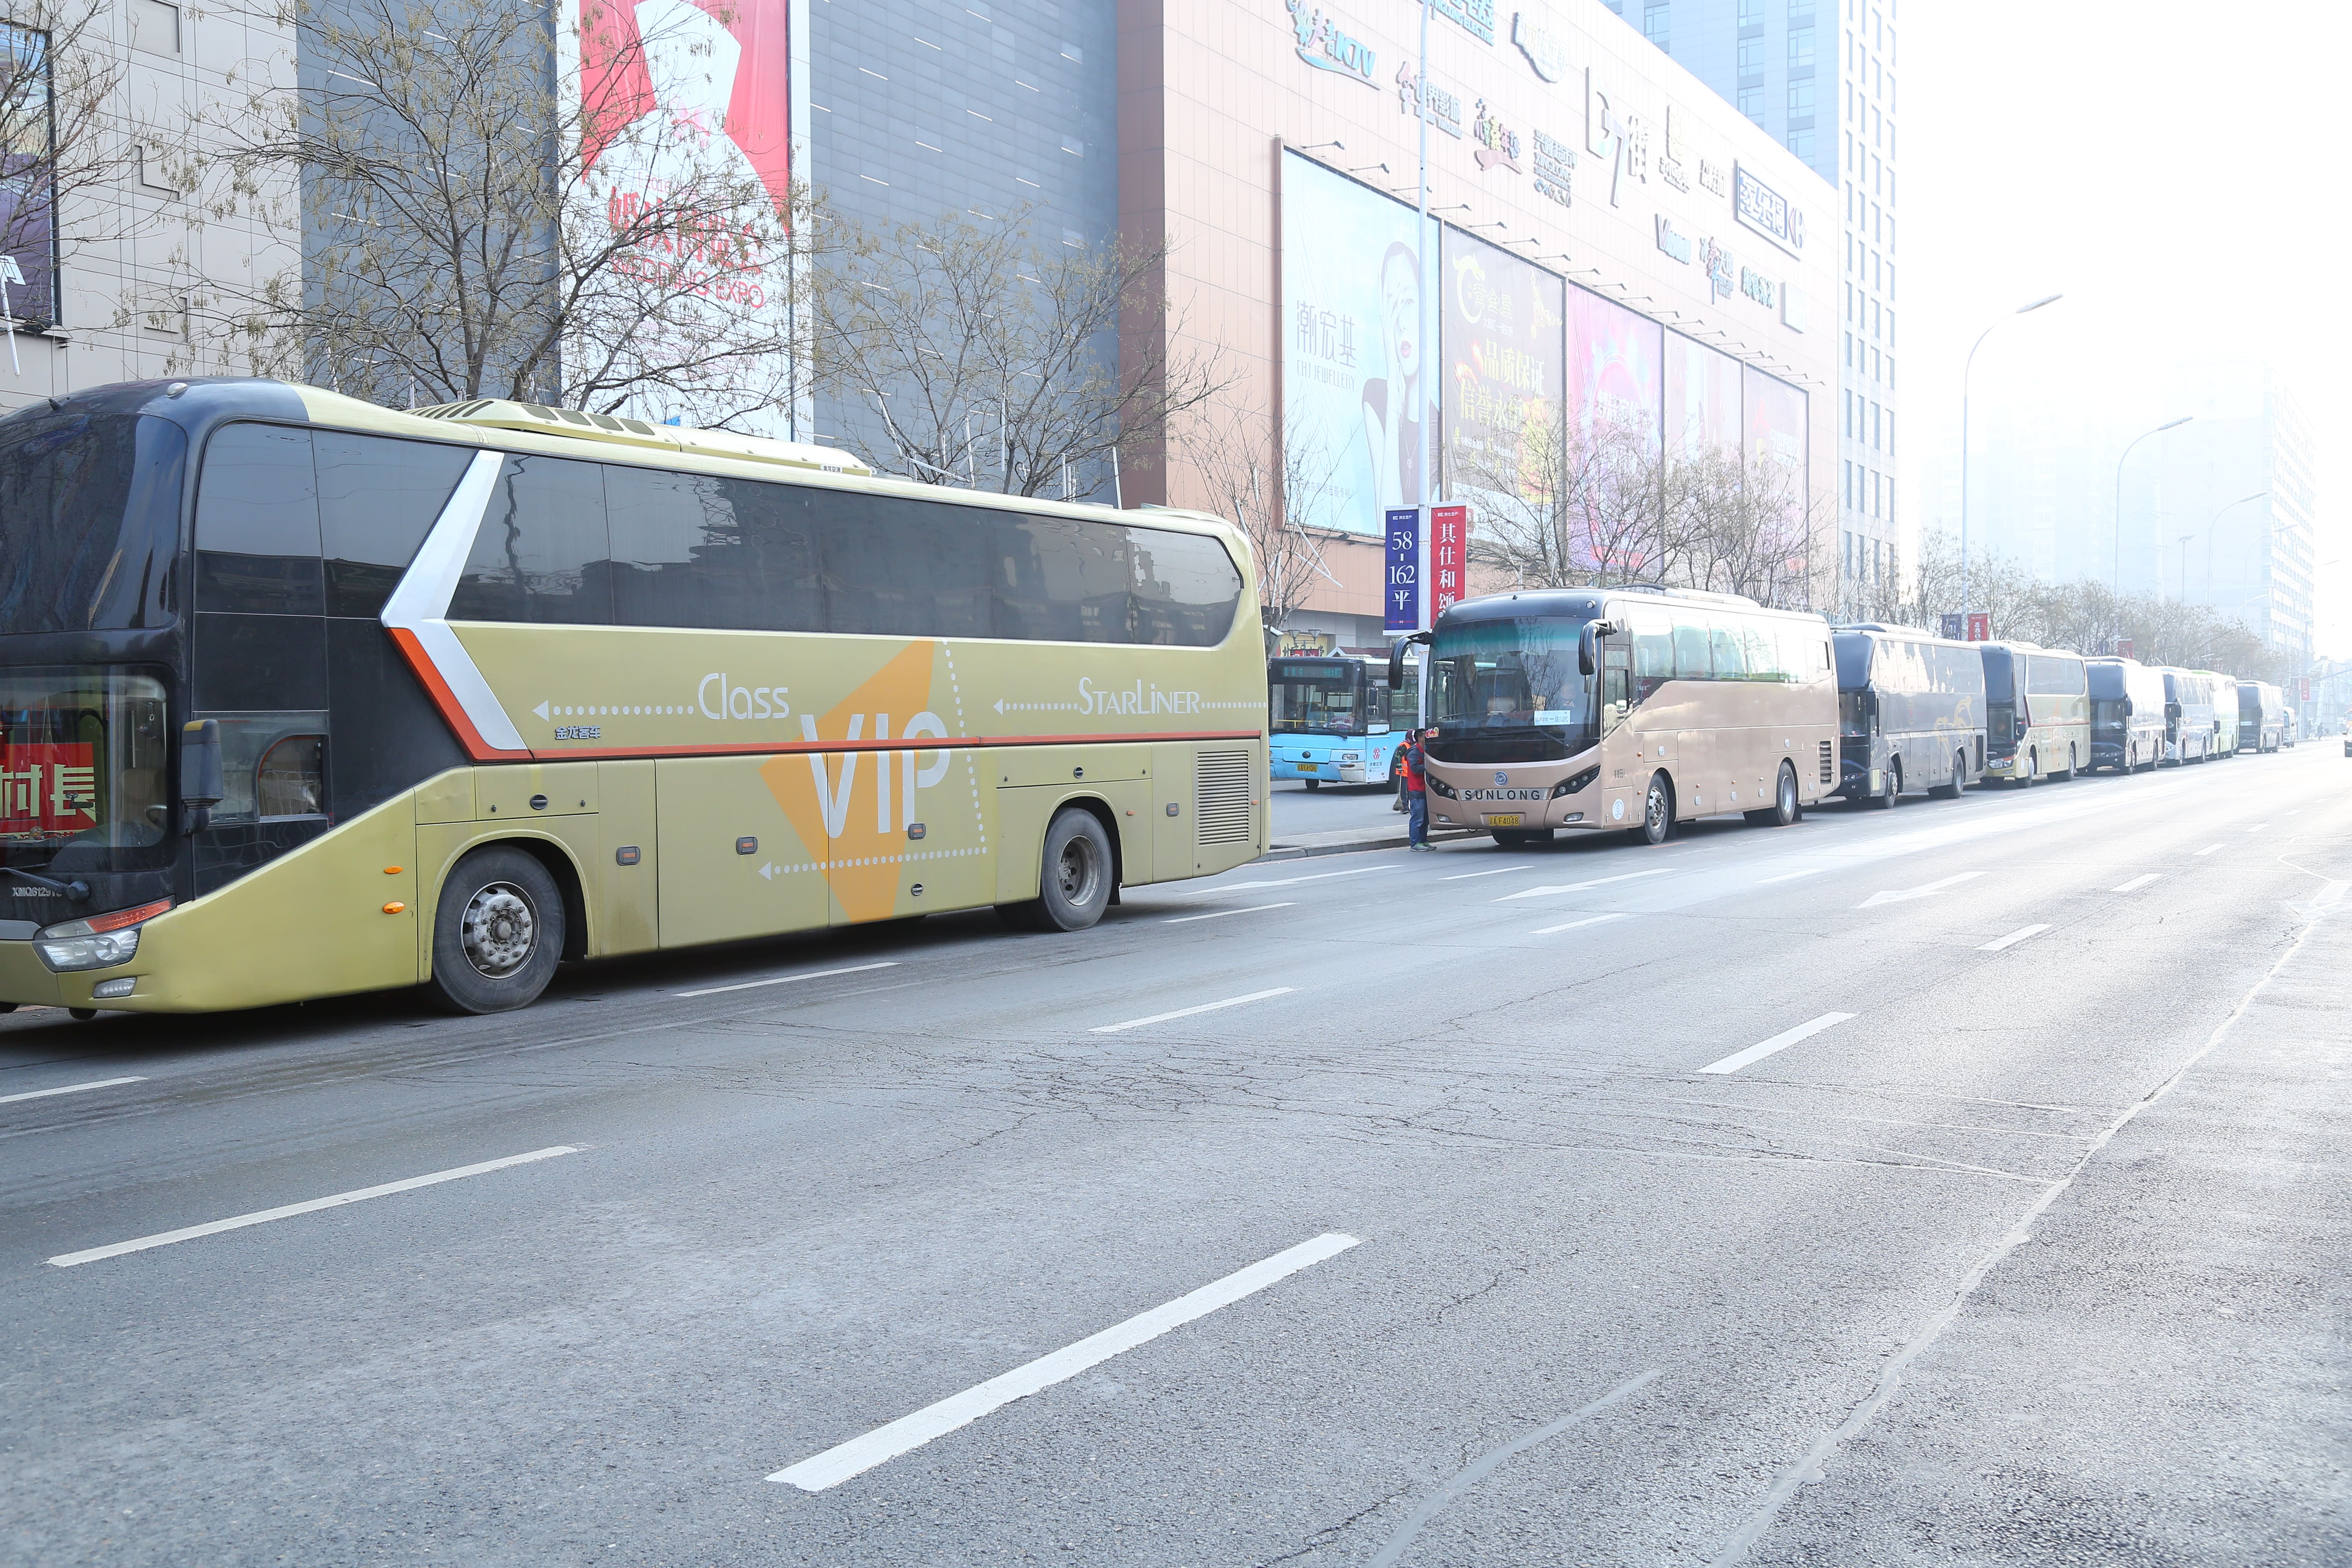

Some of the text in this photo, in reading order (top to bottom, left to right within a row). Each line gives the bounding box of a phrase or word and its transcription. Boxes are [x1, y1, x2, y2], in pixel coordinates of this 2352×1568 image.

[1463, 16, 1495, 47] ELECTRIC
[1335, 31, 1376, 78] KTV
[1534, 130, 1577, 169] 兴隆超市
[1534, 152, 1571, 181] XINGLONG
[1740, 175, 1784, 234] 家乐福
[716, 276, 764, 308] EXPO
[1297, 299, 1356, 369] 潮宏基
[1297, 359, 1356, 391] CHJ JEWELLERY
[1483, 338, 1545, 396] 品质保证
[1392, 530, 1413, 550] 58
[1389, 565, 1416, 585] 162
[1438, 523, 1457, 610] 其仕和颂
[697, 673, 789, 720] Class
[555, 725, 601, 740] 金龙客车
[800, 711, 951, 838] VIP
[1464, 789, 1541, 801] SUNLONG
